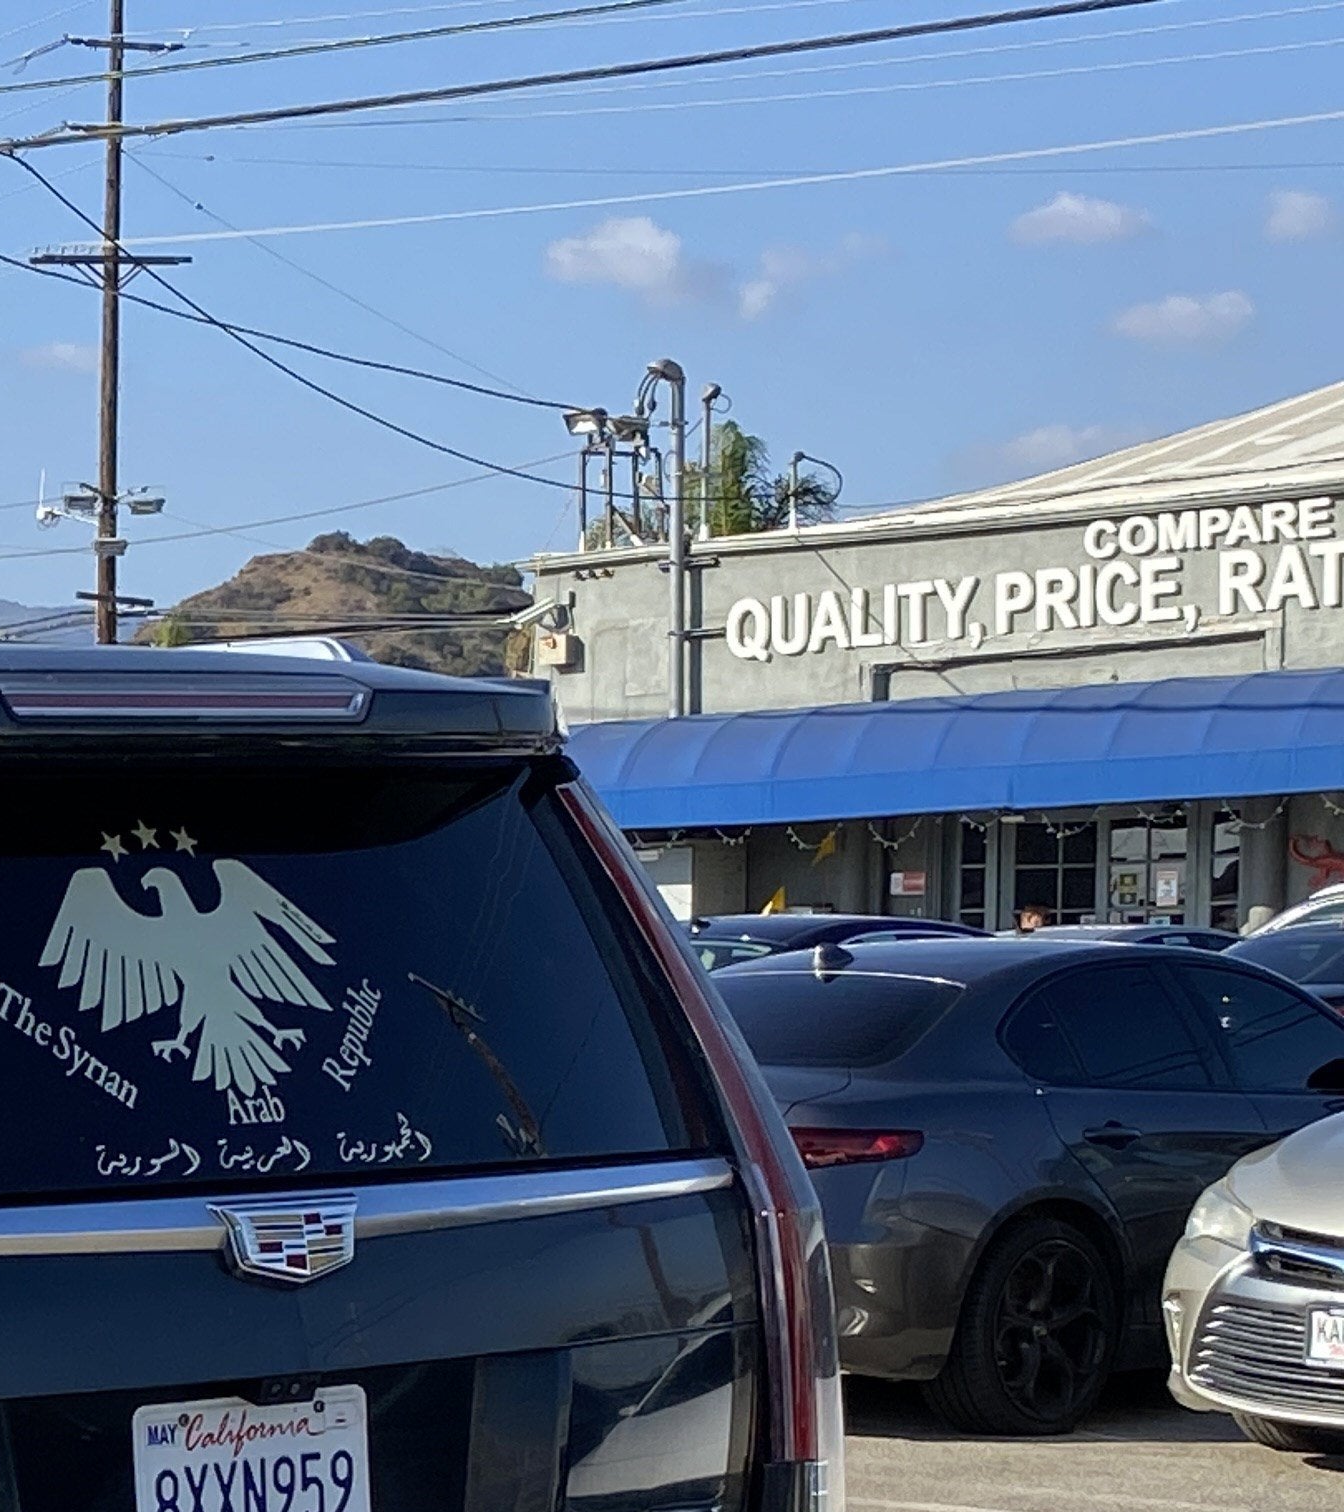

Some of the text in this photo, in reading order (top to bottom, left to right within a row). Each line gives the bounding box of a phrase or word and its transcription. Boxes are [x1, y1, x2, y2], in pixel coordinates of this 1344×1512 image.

[1083, 497, 1334, 561] COMPARE
[725, 574, 987, 663] QUALITY,
[994, 556, 1201, 634] PRICE,
[321, 978, 382, 1093] Republic
[52, 1026, 139, 1109] Syrian
[226, 1084, 286, 1125] Arab
[1316, 1317, 1344, 1344] KA
[147, 1424, 178, 1445] MAY
[185, 1409, 326, 1458] California
